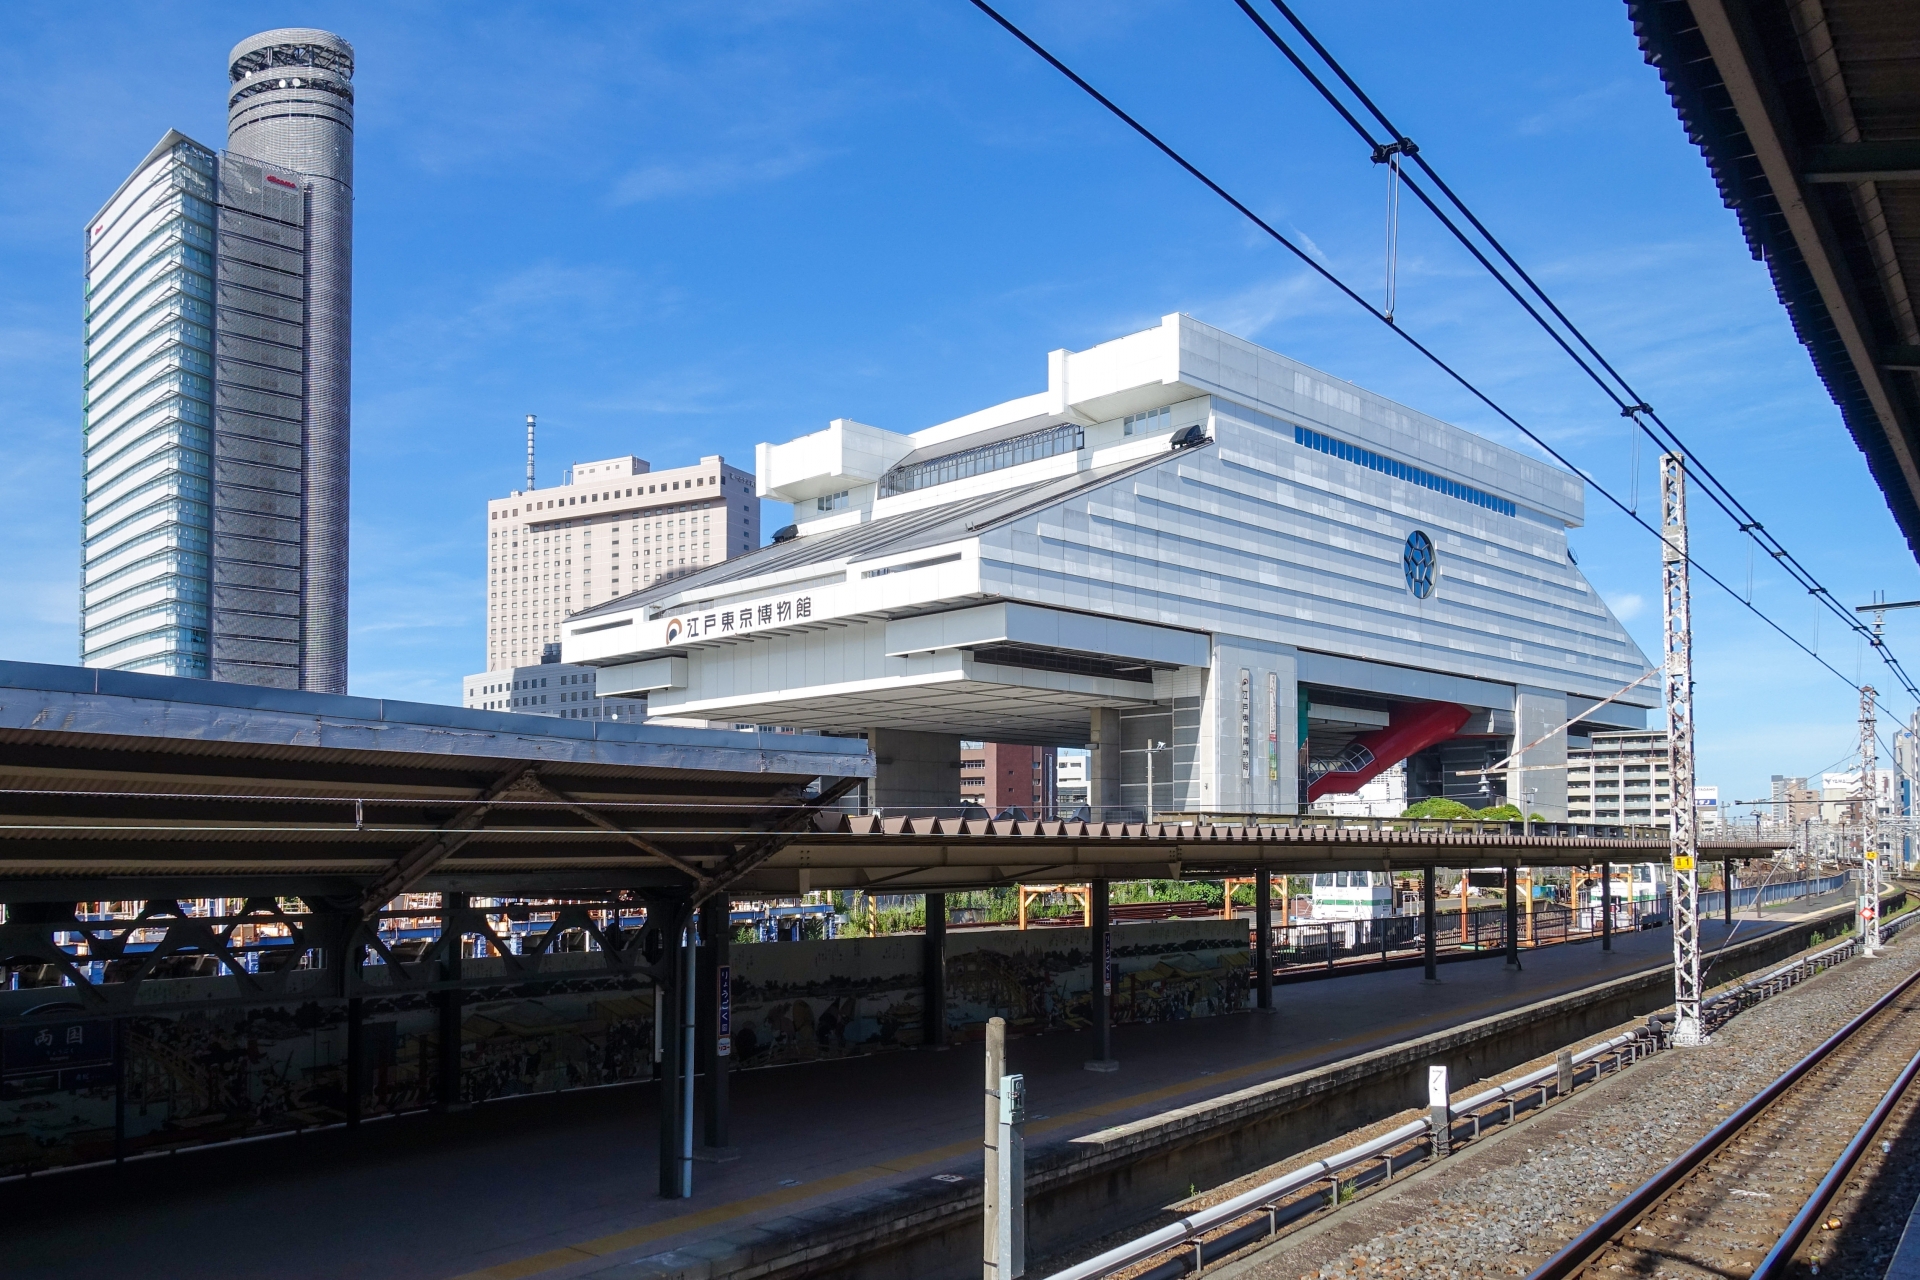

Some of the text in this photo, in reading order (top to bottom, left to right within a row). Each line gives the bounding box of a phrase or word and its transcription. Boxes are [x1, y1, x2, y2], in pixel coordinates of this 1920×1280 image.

[686, 596, 811, 638] 江戸東京博物館
[1493, 875, 1500, 886] 3
[34, 1025, 83, 1047] 両国
